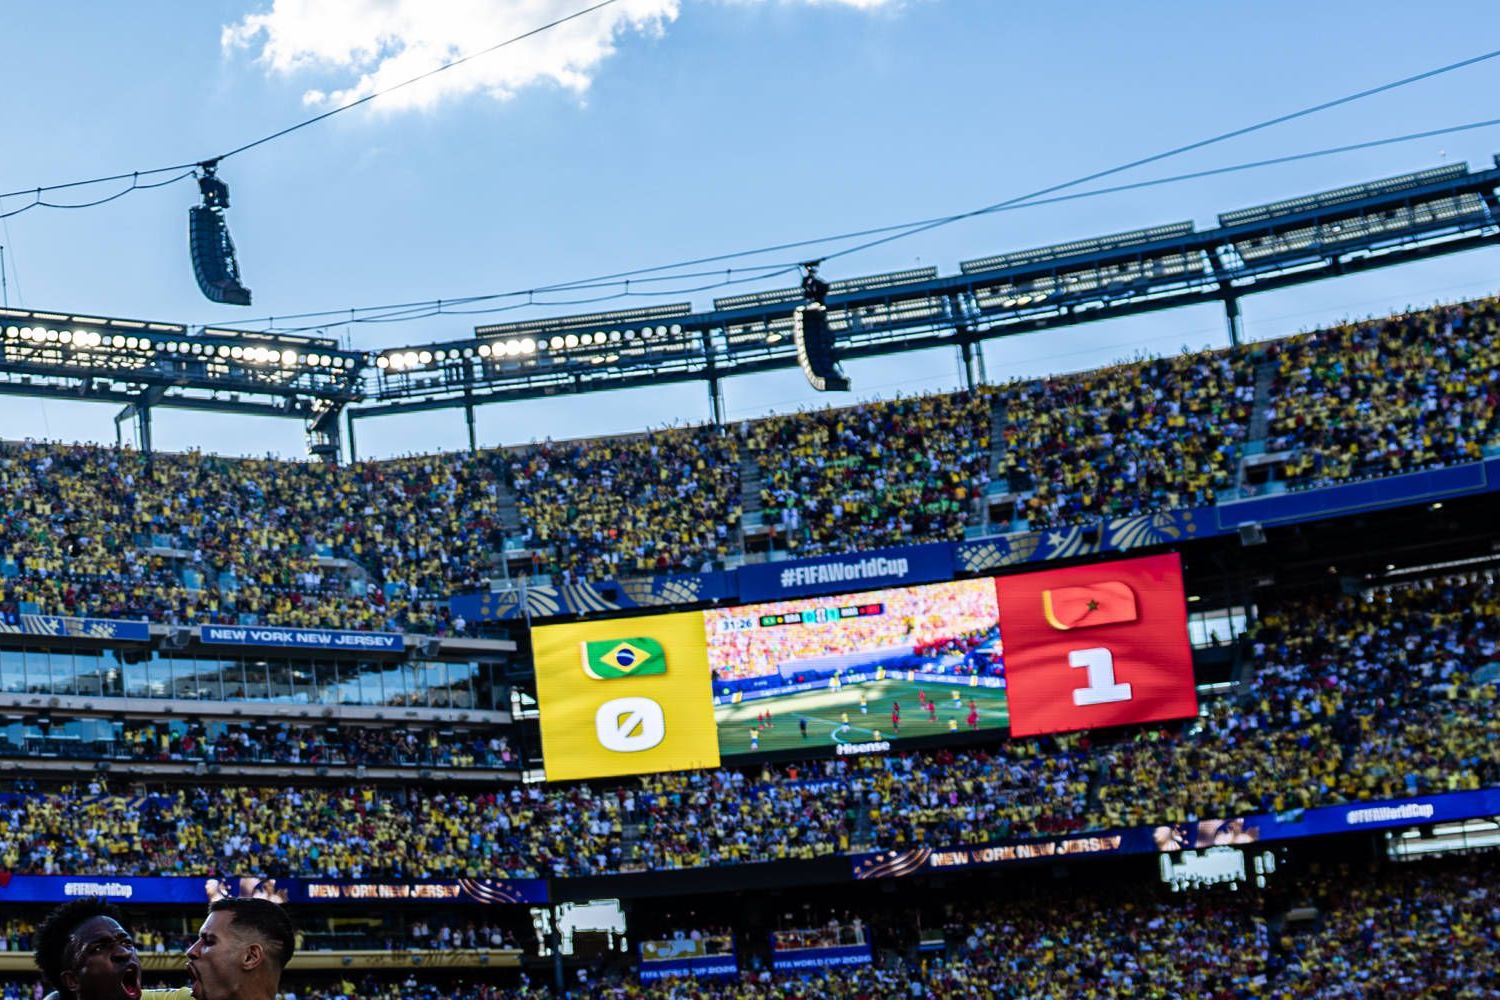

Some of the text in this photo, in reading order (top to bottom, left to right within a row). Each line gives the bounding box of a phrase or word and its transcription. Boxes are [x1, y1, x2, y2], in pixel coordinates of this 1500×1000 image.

[781, 557, 908, 588] #FIFAWorldCup
[723, 619, 753, 631] 31:26
[210, 629, 394, 646] NEW YORK NEW JERSEY
[1068, 647, 1132, 706] 1
[596, 697, 666, 752] 0
[836, 741, 890, 755] Hisense
[930, 835, 1122, 867] NEW YORK NEW JERSEY
[308, 884, 460, 898] NEW YORK NEW JERSEY
